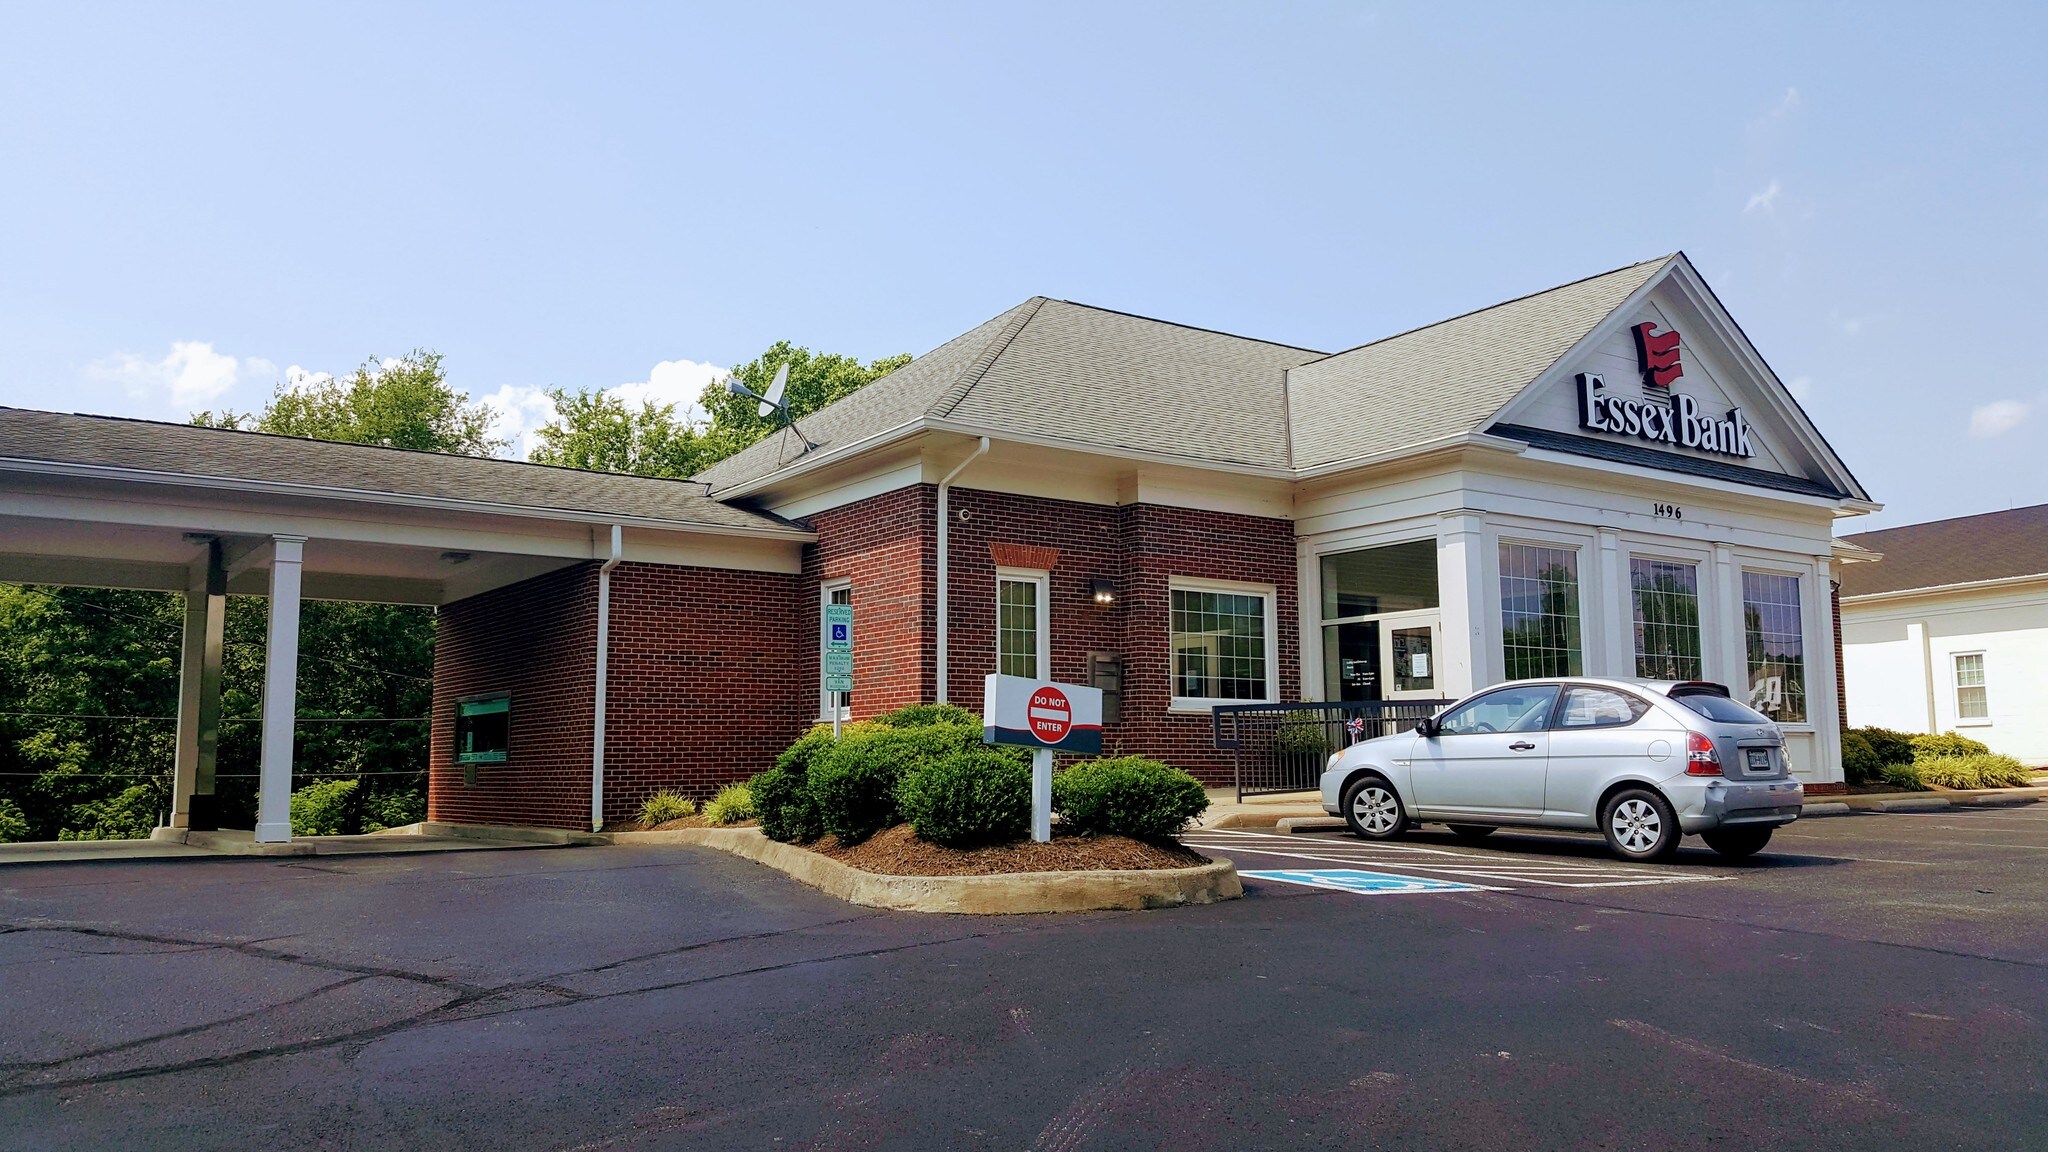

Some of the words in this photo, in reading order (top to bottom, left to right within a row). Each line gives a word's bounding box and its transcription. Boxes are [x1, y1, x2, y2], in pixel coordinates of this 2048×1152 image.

[1576, 372, 1676, 444] Essex
[1672, 394, 1756, 458] Bank
[1653, 503, 1682, 519] 1496
[828, 608, 851, 616] RESERVED
[1034, 695, 1047, 705] DO
[1049, 698, 1066, 708] NOT
[1037, 721, 1062, 732] ENTER
